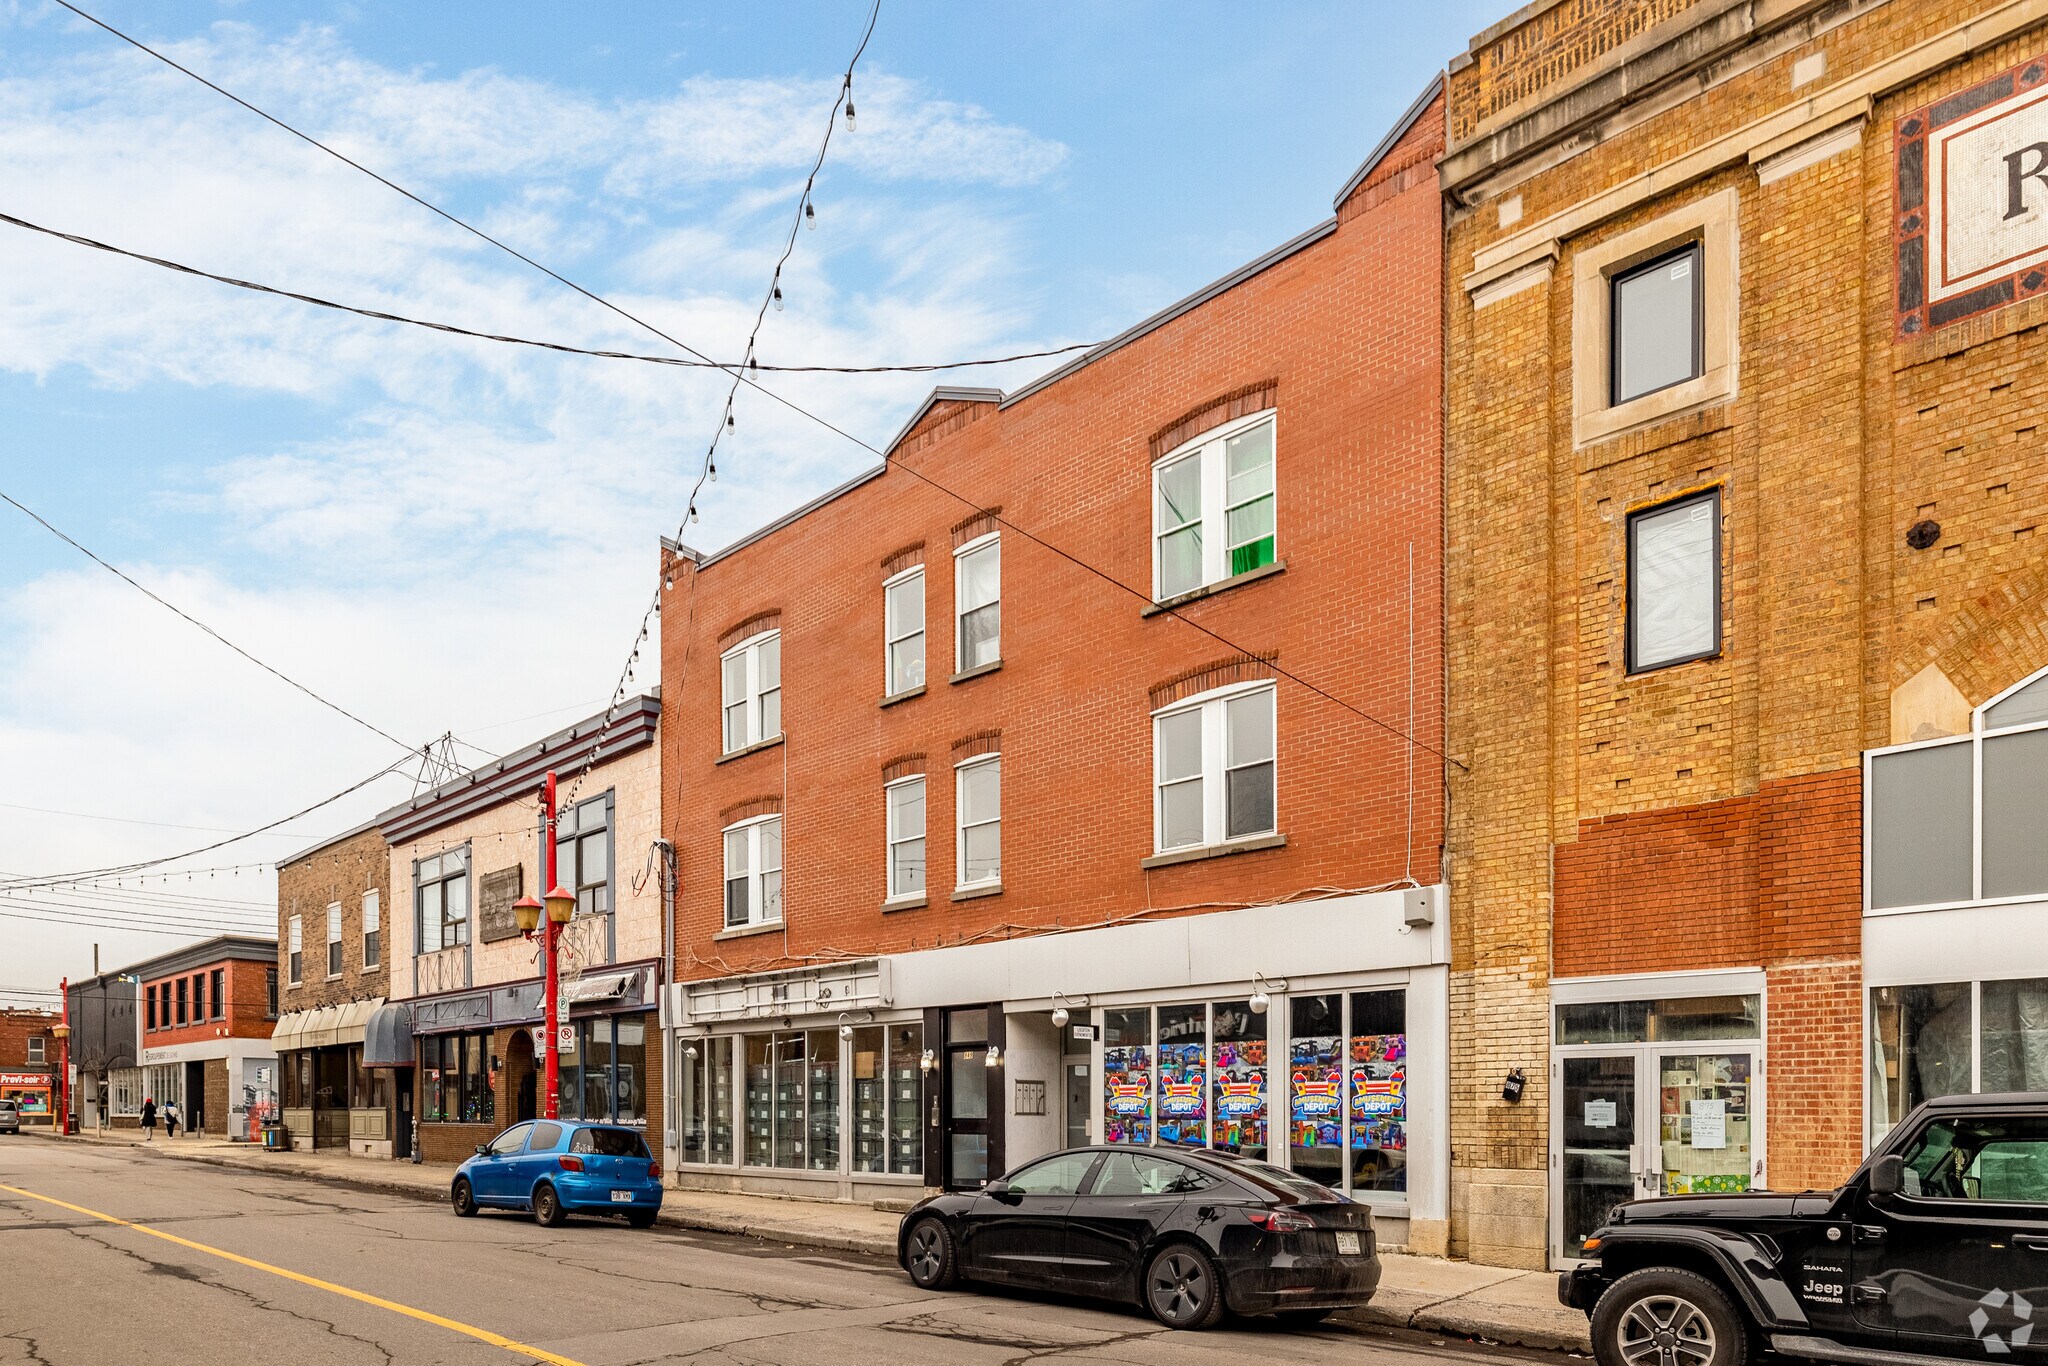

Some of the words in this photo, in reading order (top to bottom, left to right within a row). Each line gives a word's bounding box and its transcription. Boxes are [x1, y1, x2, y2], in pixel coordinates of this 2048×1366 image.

[0, 1075, 40, 1084] Provi-soir
[1111, 1096, 1147, 1106] AMUSEMENT
[1163, 1096, 1200, 1105] AMUSEMENT
[1220, 1096, 1260, 1106] AMUSEMENT
[1295, 1095, 1338, 1106] AMUSEMENT
[1354, 1095, 1402, 1106] AMUSEMENT
[1118, 1102, 1138, 1111] DÉPÔT
[1171, 1101, 1193, 1111] DÉPÔT
[1228, 1101, 1251, 1111] DÉPÔT
[1304, 1101, 1328, 1111] DÉPÔT
[1364, 1101, 1391, 1111] DÉPÔT
[1803, 1264, 1843, 1273] SAHARA
[1803, 1280, 1844, 1297] Jeep
